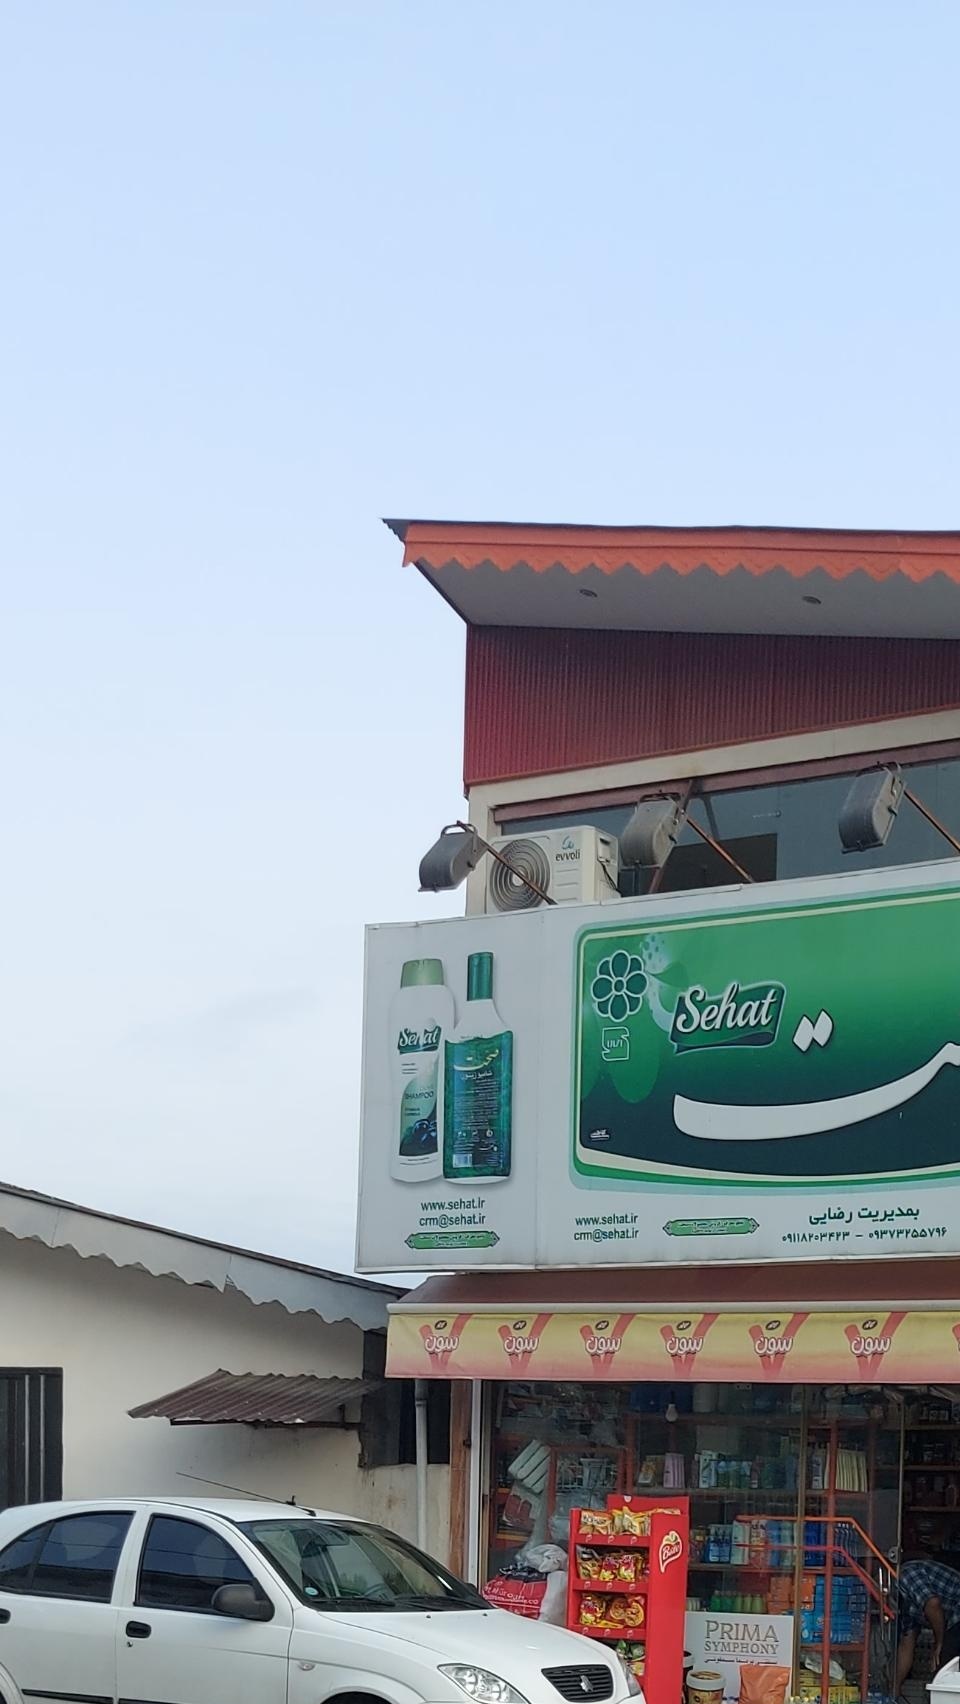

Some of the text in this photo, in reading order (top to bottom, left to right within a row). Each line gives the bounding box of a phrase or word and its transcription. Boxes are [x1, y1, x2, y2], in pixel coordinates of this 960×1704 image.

[555, 848, 581, 862] evvoli
[675, 982, 778, 1034] Sehat
[420, 1197, 486, 1212] www.sehat.ir
[419, 1213, 487, 1229] crm@sehat.ir
[574, 1212, 639, 1227] www.sehat.ir
[808, 1204, 920, 1226] بمدیریت رضایی
[573, 1227, 640, 1243] crm@sehat.ir
[704, 1619, 780, 1643] PRIMA
[703, 1640, 780, 1655] SYMPHONY
